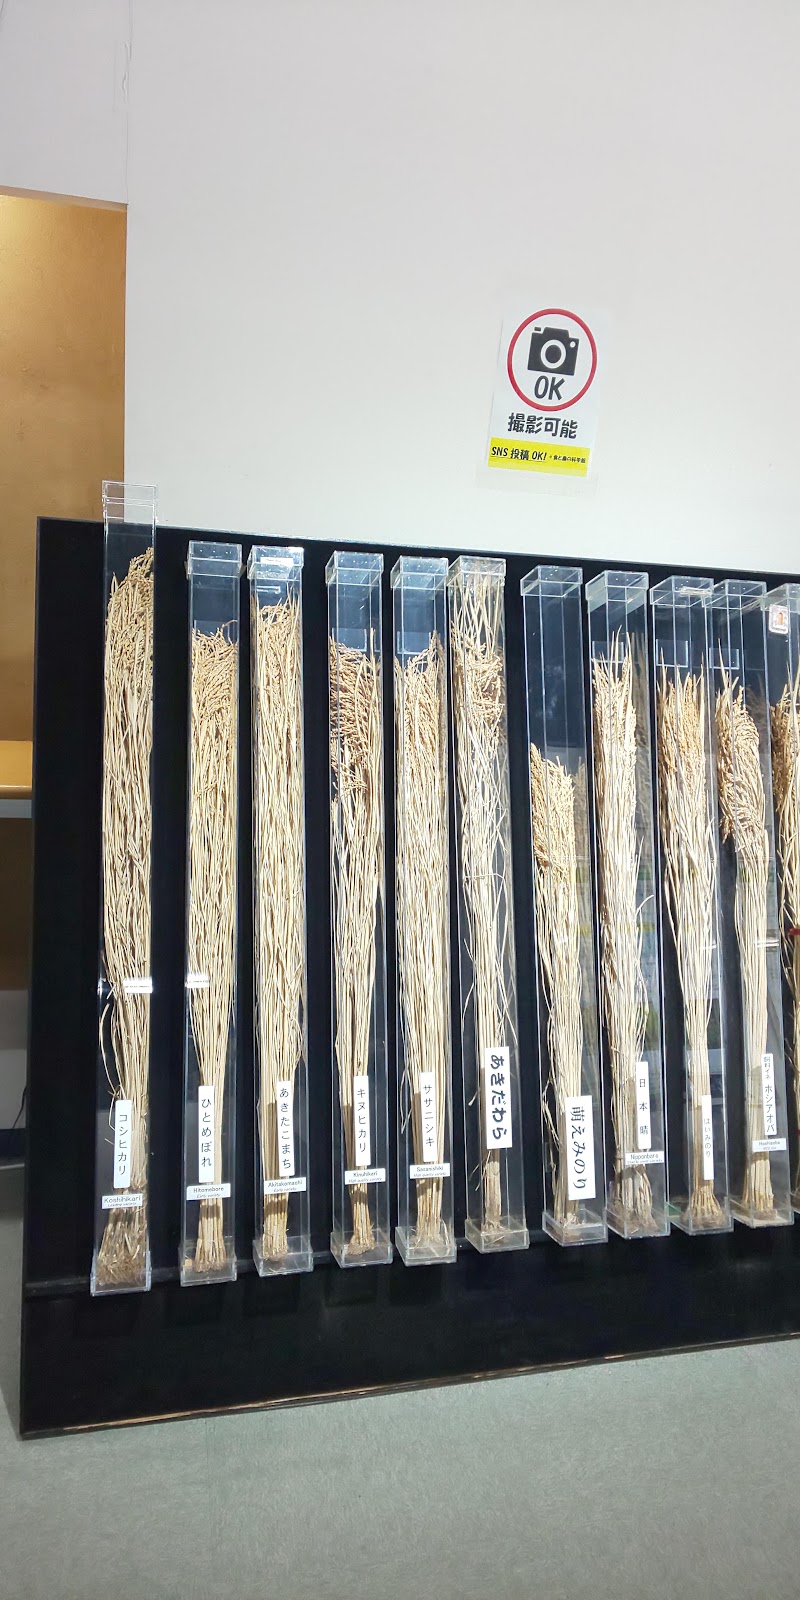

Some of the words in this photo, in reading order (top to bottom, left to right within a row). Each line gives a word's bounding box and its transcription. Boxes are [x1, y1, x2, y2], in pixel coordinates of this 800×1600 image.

[534, 375, 565, 401] OK
[491, 446, 508, 457] SNS
[510, 448, 529, 460] 投稿
[532, 451, 547, 461] OK!
[508, 412, 578, 439] 撮影可能
[279, 1087, 291, 1169] あきたこまち
[357, 1088, 367, 1153] キヌヒカリ
[423, 1084, 435, 1147] ササニシキ
[490, 1054, 507, 1140] あきだわら
[765, 1084, 775, 1133] ホシアオバ
[118, 1114, 128, 1176] コシヒカリ
[201, 1098, 212, 1168] ひとめぼれ
[570, 1105, 586, 1189] 萌えみのり
[703, 1118, 712, 1158] はいみのり
[103, 1195, 141, 1205] Koshihikari
